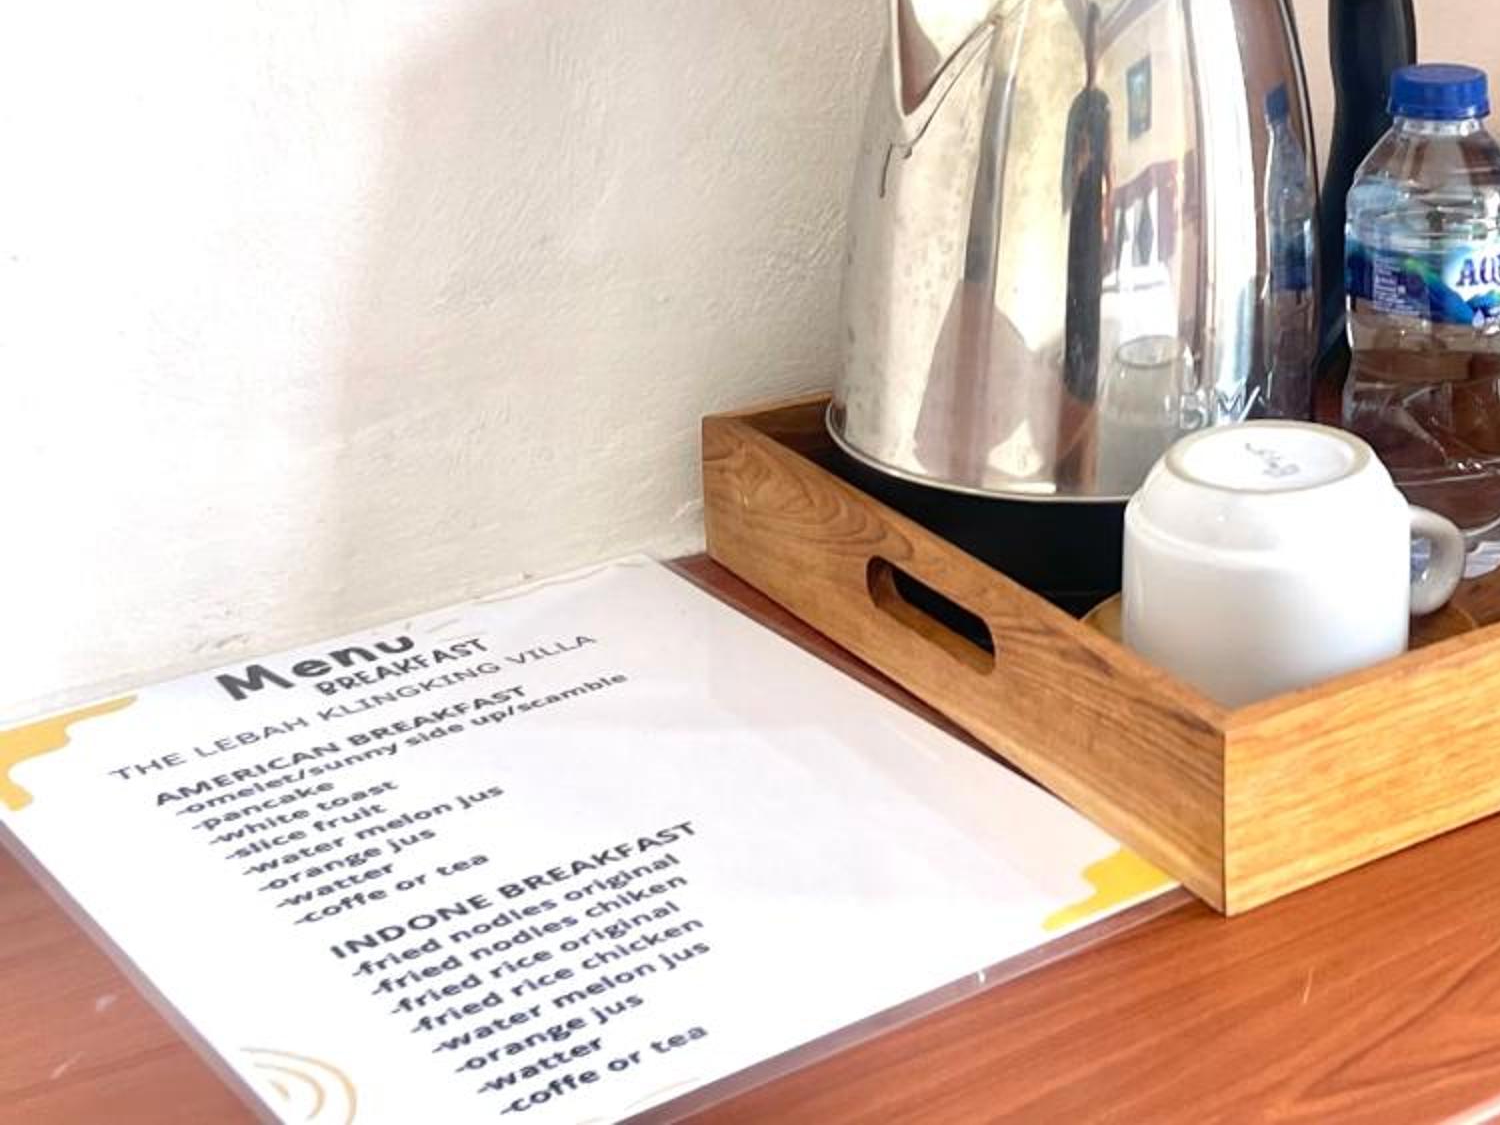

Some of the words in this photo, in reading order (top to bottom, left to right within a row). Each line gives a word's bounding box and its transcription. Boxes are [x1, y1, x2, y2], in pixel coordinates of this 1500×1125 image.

[214, 636, 414, 701] Menu
[314, 638, 488, 695] BREAKFAST
[108, 752, 187, 780] THE
[193, 717, 310, 757] LEBAH
[317, 662, 501, 720] KLINGKING
[505, 635, 597, 665] VILLA
[156, 742, 341, 806] AMERICAN
[347, 685, 527, 746] BREAKFAST
[405, 723, 464, 746] side
[470, 674, 628, 724] up/scamble
[192, 781, 334, 830] -pancake
[209, 809, 310, 845] -white
[316, 780, 398, 811] toast
[225, 829, 307, 860] -slice
[313, 804, 387, 832] fruit
[242, 837, 345, 875] -water
[354, 803, 453, 840] melon
[456, 786, 504, 809] jus
[258, 847, 382, 891] -orange
[386, 829, 436, 853] jus
[330, 894, 493, 959] INDONE
[498, 821, 696, 899] BREAKFAST
[395, 874, 427, 891] or
[435, 855, 489, 876] tea
[352, 938, 442, 977] -fried
[449, 899, 558, 943] nodles
[564, 853, 680, 902] original
[371, 955, 463, 995] -fried
[469, 914, 579, 961] nodles
[585, 874, 688, 919] chiken
[391, 974, 483, 1014] -fried
[489, 949, 553, 979] rice
[560, 901, 680, 952] original
[410, 992, 504, 1034] -fried
[511, 967, 575, 997] rice
[581, 918, 703, 971] chicken
[432, 1004, 542, 1054] -water
[552, 962, 657, 1009] melon
[658, 940, 711, 971] jus
[454, 1016, 587, 1073] -orange
[590, 994, 644, 1024] jus
[607, 1049, 641, 1073] or
[650, 1025, 708, 1055] tea
